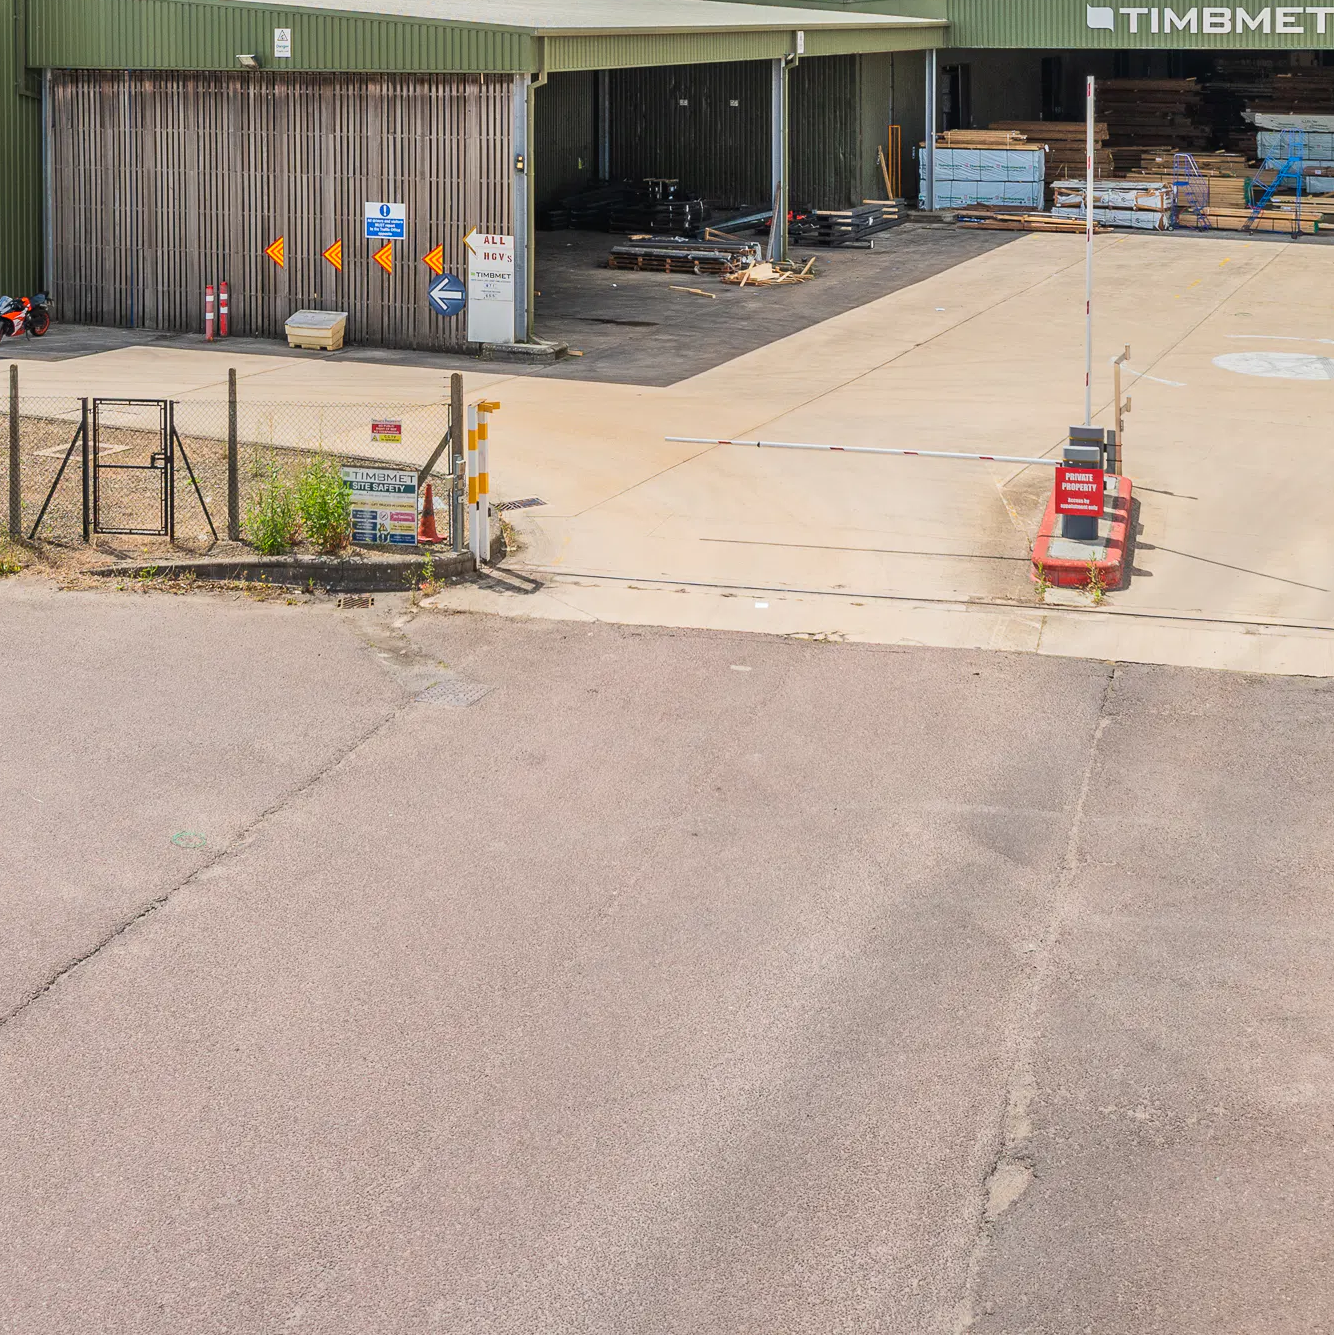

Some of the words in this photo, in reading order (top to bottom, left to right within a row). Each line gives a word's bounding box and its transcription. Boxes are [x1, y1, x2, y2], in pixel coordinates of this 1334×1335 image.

[484, 236, 506, 245] ALL
[352, 472, 416, 483] TIMBMET
[1065, 473, 1094, 481] PRIVATE
[352, 482, 371, 490] SITE
[372, 484, 405, 492] SAFETY
[1061, 482, 1097, 492] PROPERTY
